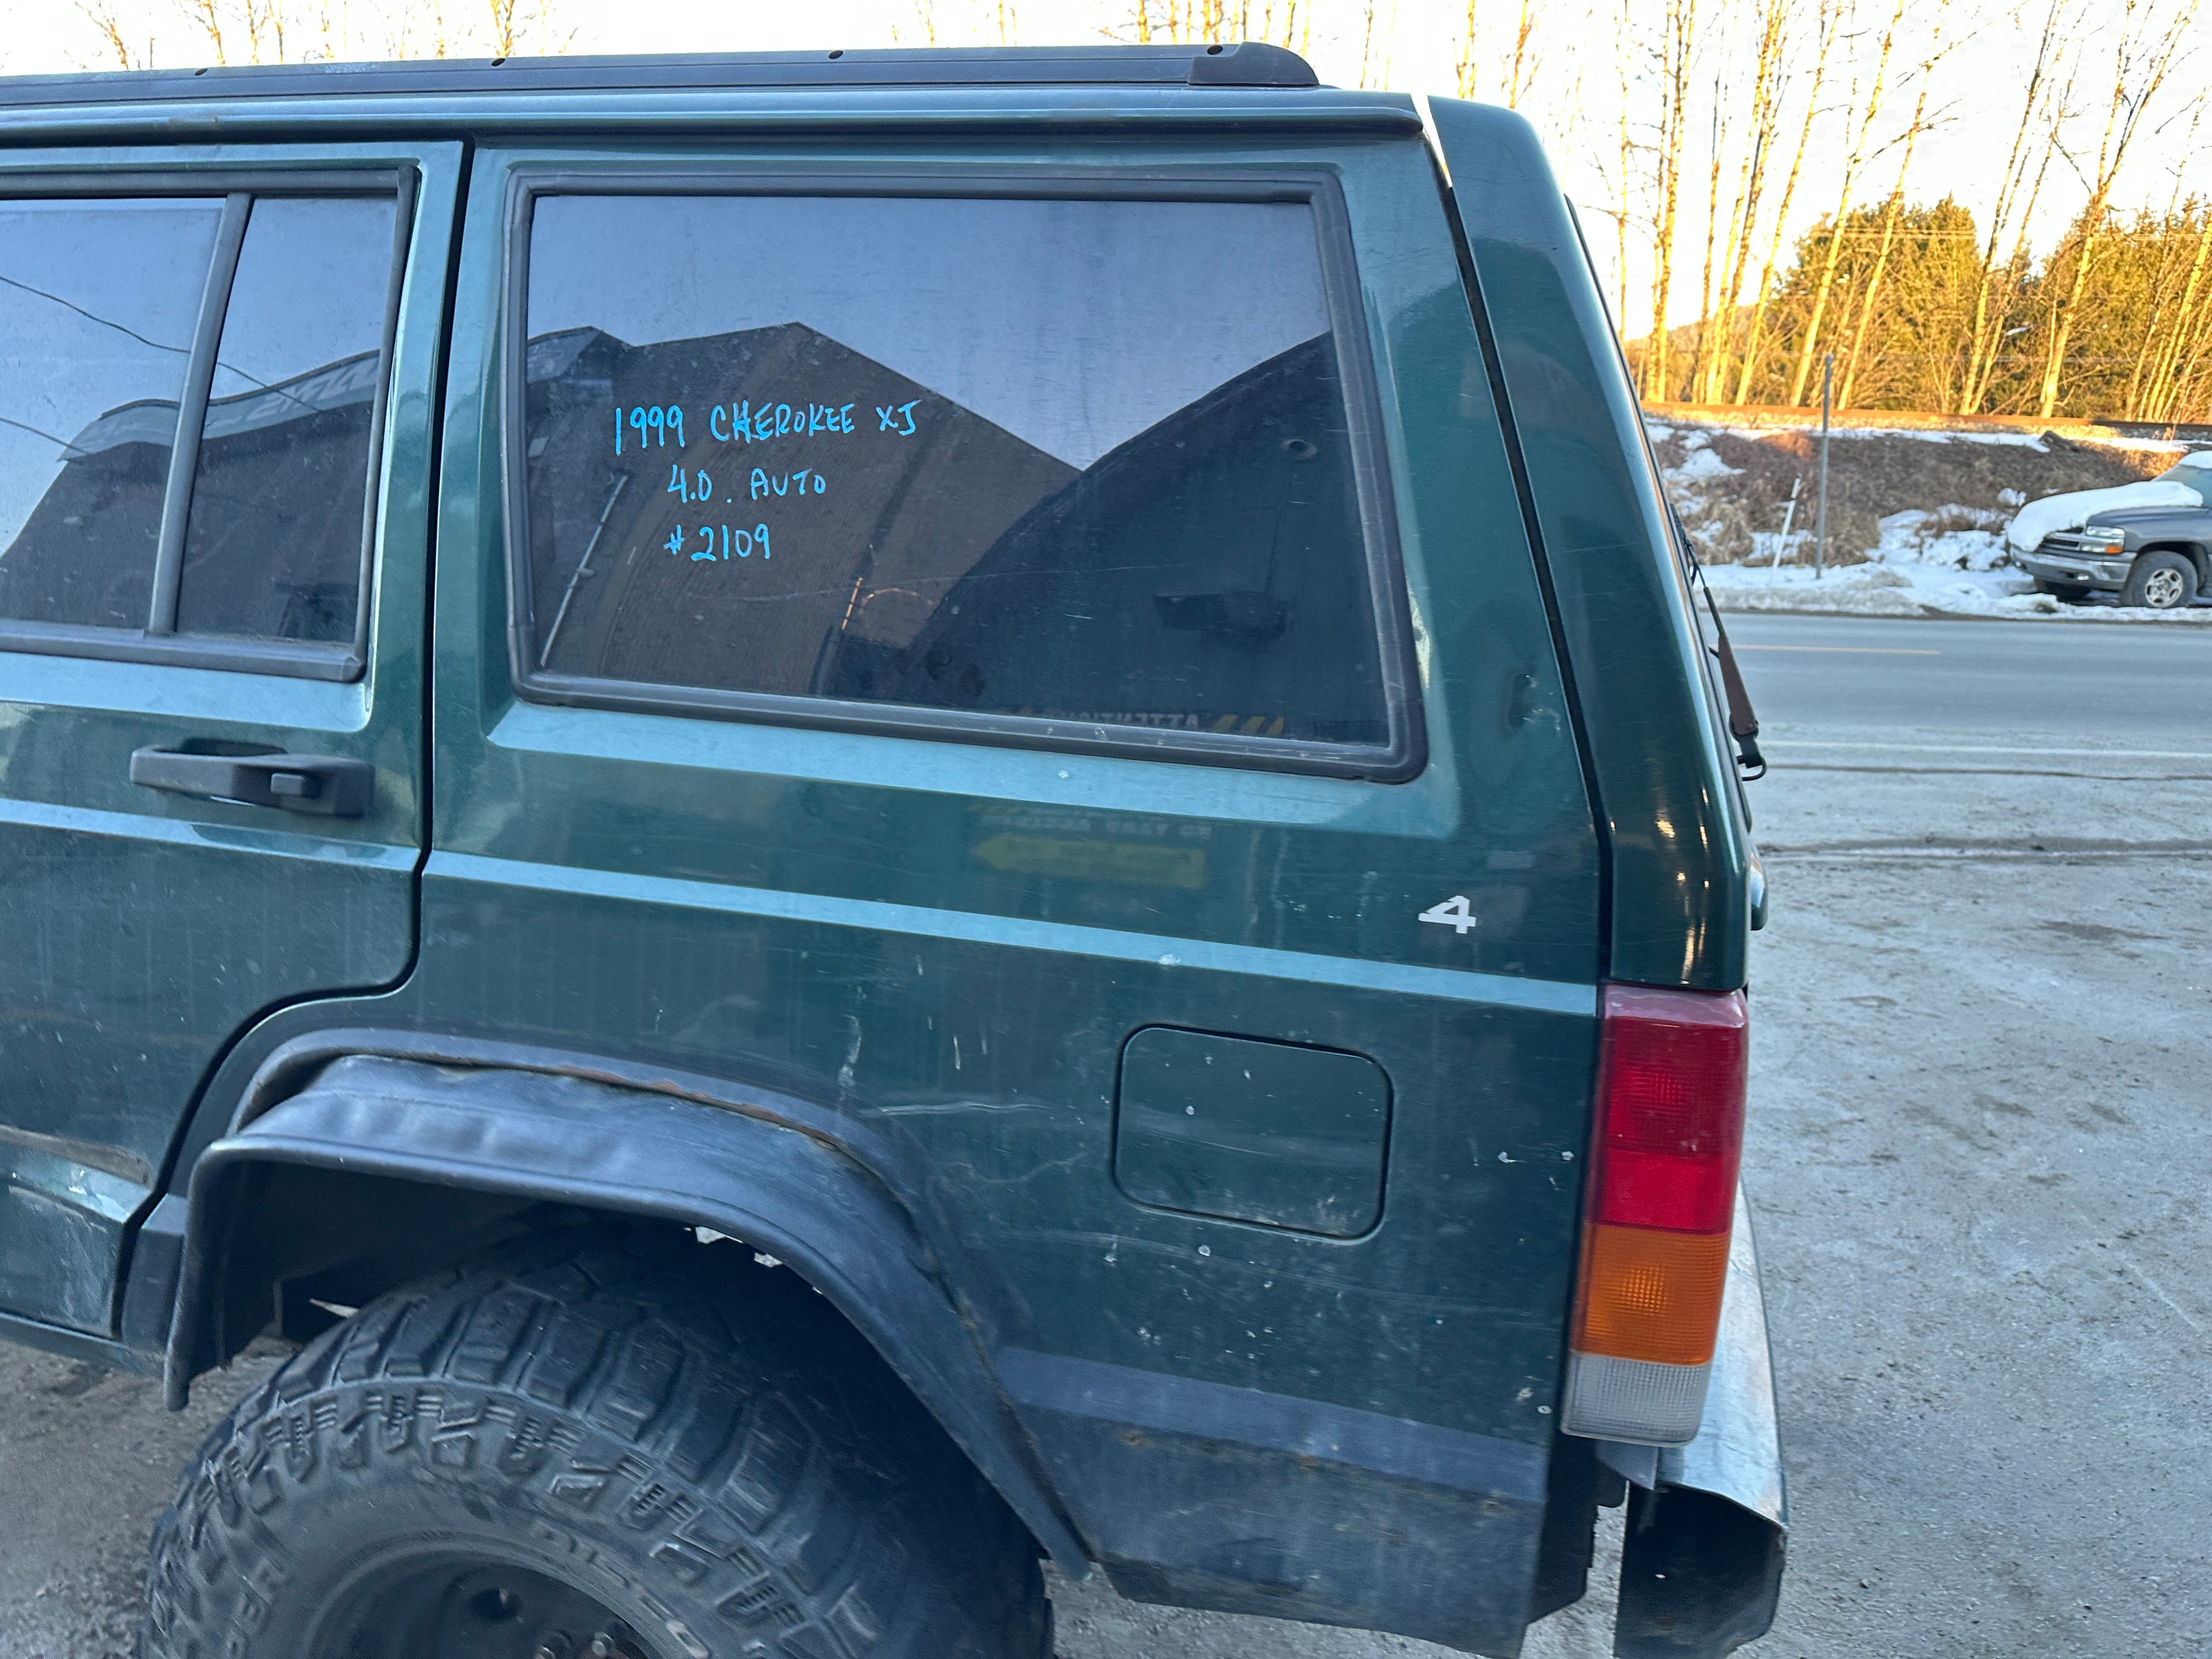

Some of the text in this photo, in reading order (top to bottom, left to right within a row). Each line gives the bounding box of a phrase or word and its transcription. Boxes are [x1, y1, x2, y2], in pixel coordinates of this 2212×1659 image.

[614, 404, 685, 455] 1999
[709, 399, 855, 443] CHEROKEE
[750, 467, 826, 501] AUTO
[662, 522, 771, 562] #2109
[1418, 895, 1477, 935] 4
